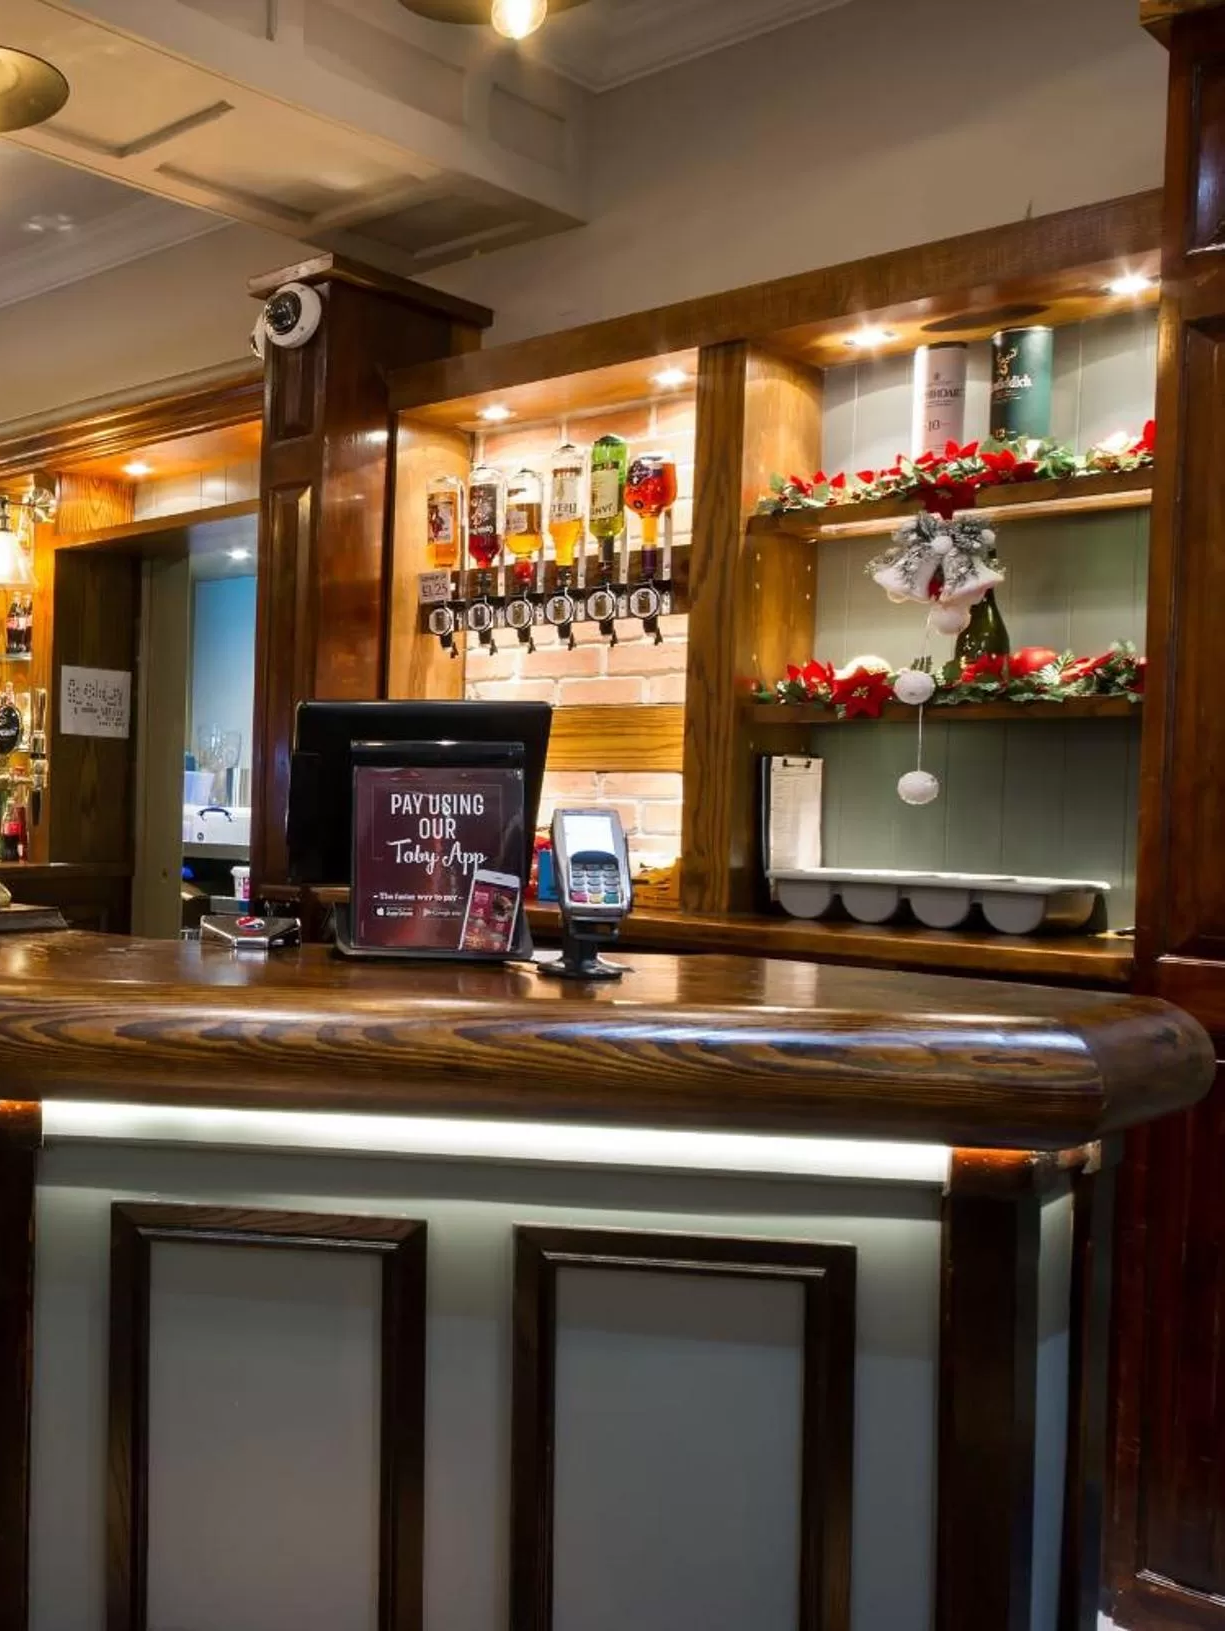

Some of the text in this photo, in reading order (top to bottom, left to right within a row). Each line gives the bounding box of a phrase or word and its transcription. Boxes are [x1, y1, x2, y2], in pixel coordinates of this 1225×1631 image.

[390, 793, 485, 816] PAY USING
[418, 817, 456, 840] OUR
[386, 838, 488, 876] Toby App
